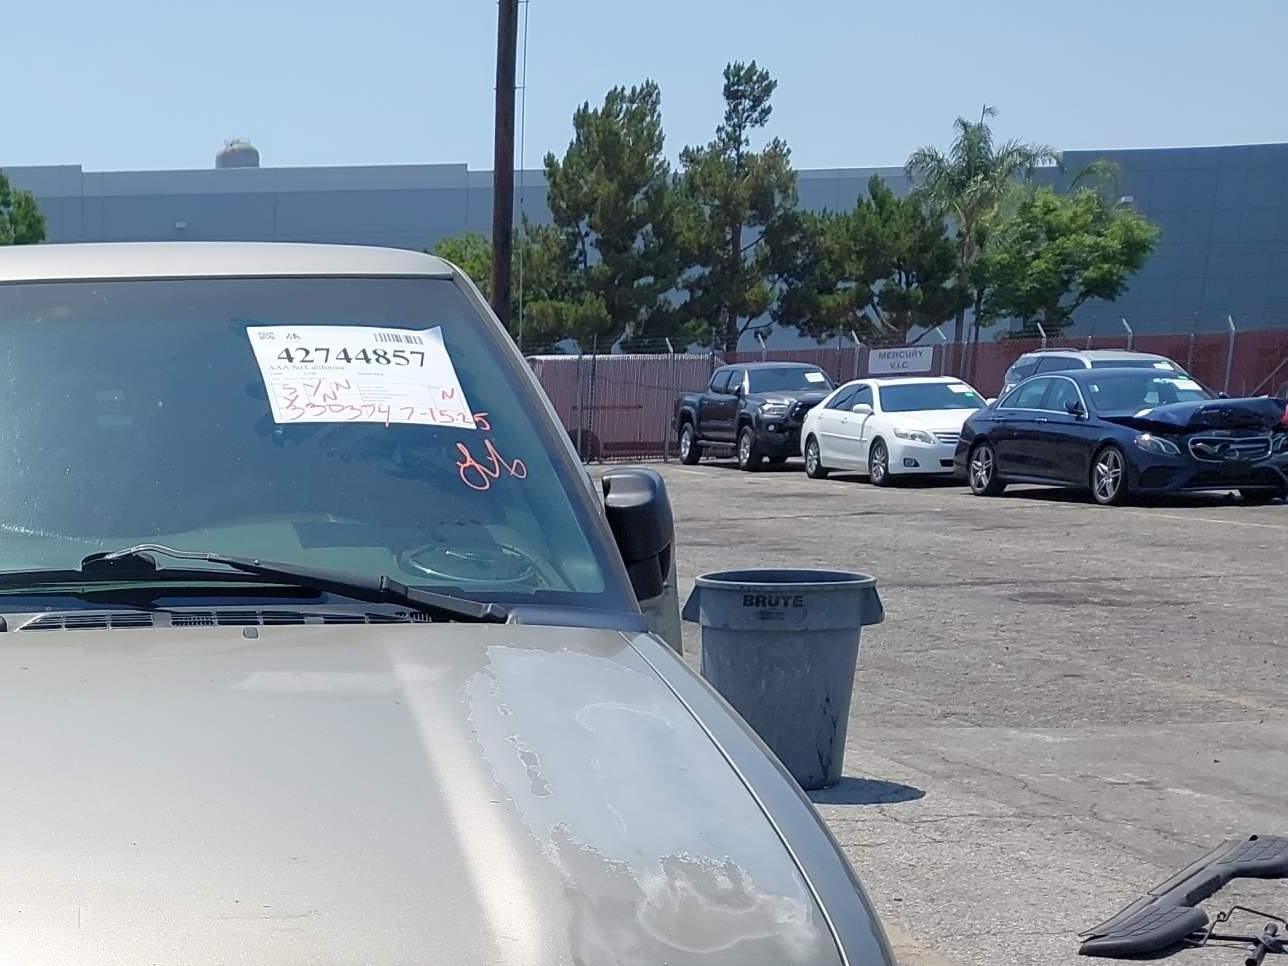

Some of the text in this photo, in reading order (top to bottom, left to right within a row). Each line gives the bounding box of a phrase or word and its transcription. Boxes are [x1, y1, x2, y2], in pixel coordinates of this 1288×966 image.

[277, 347, 425, 367] 42744857
[878, 350, 923, 360] MERCURY
[743, 594, 804, 608] BRUTE
